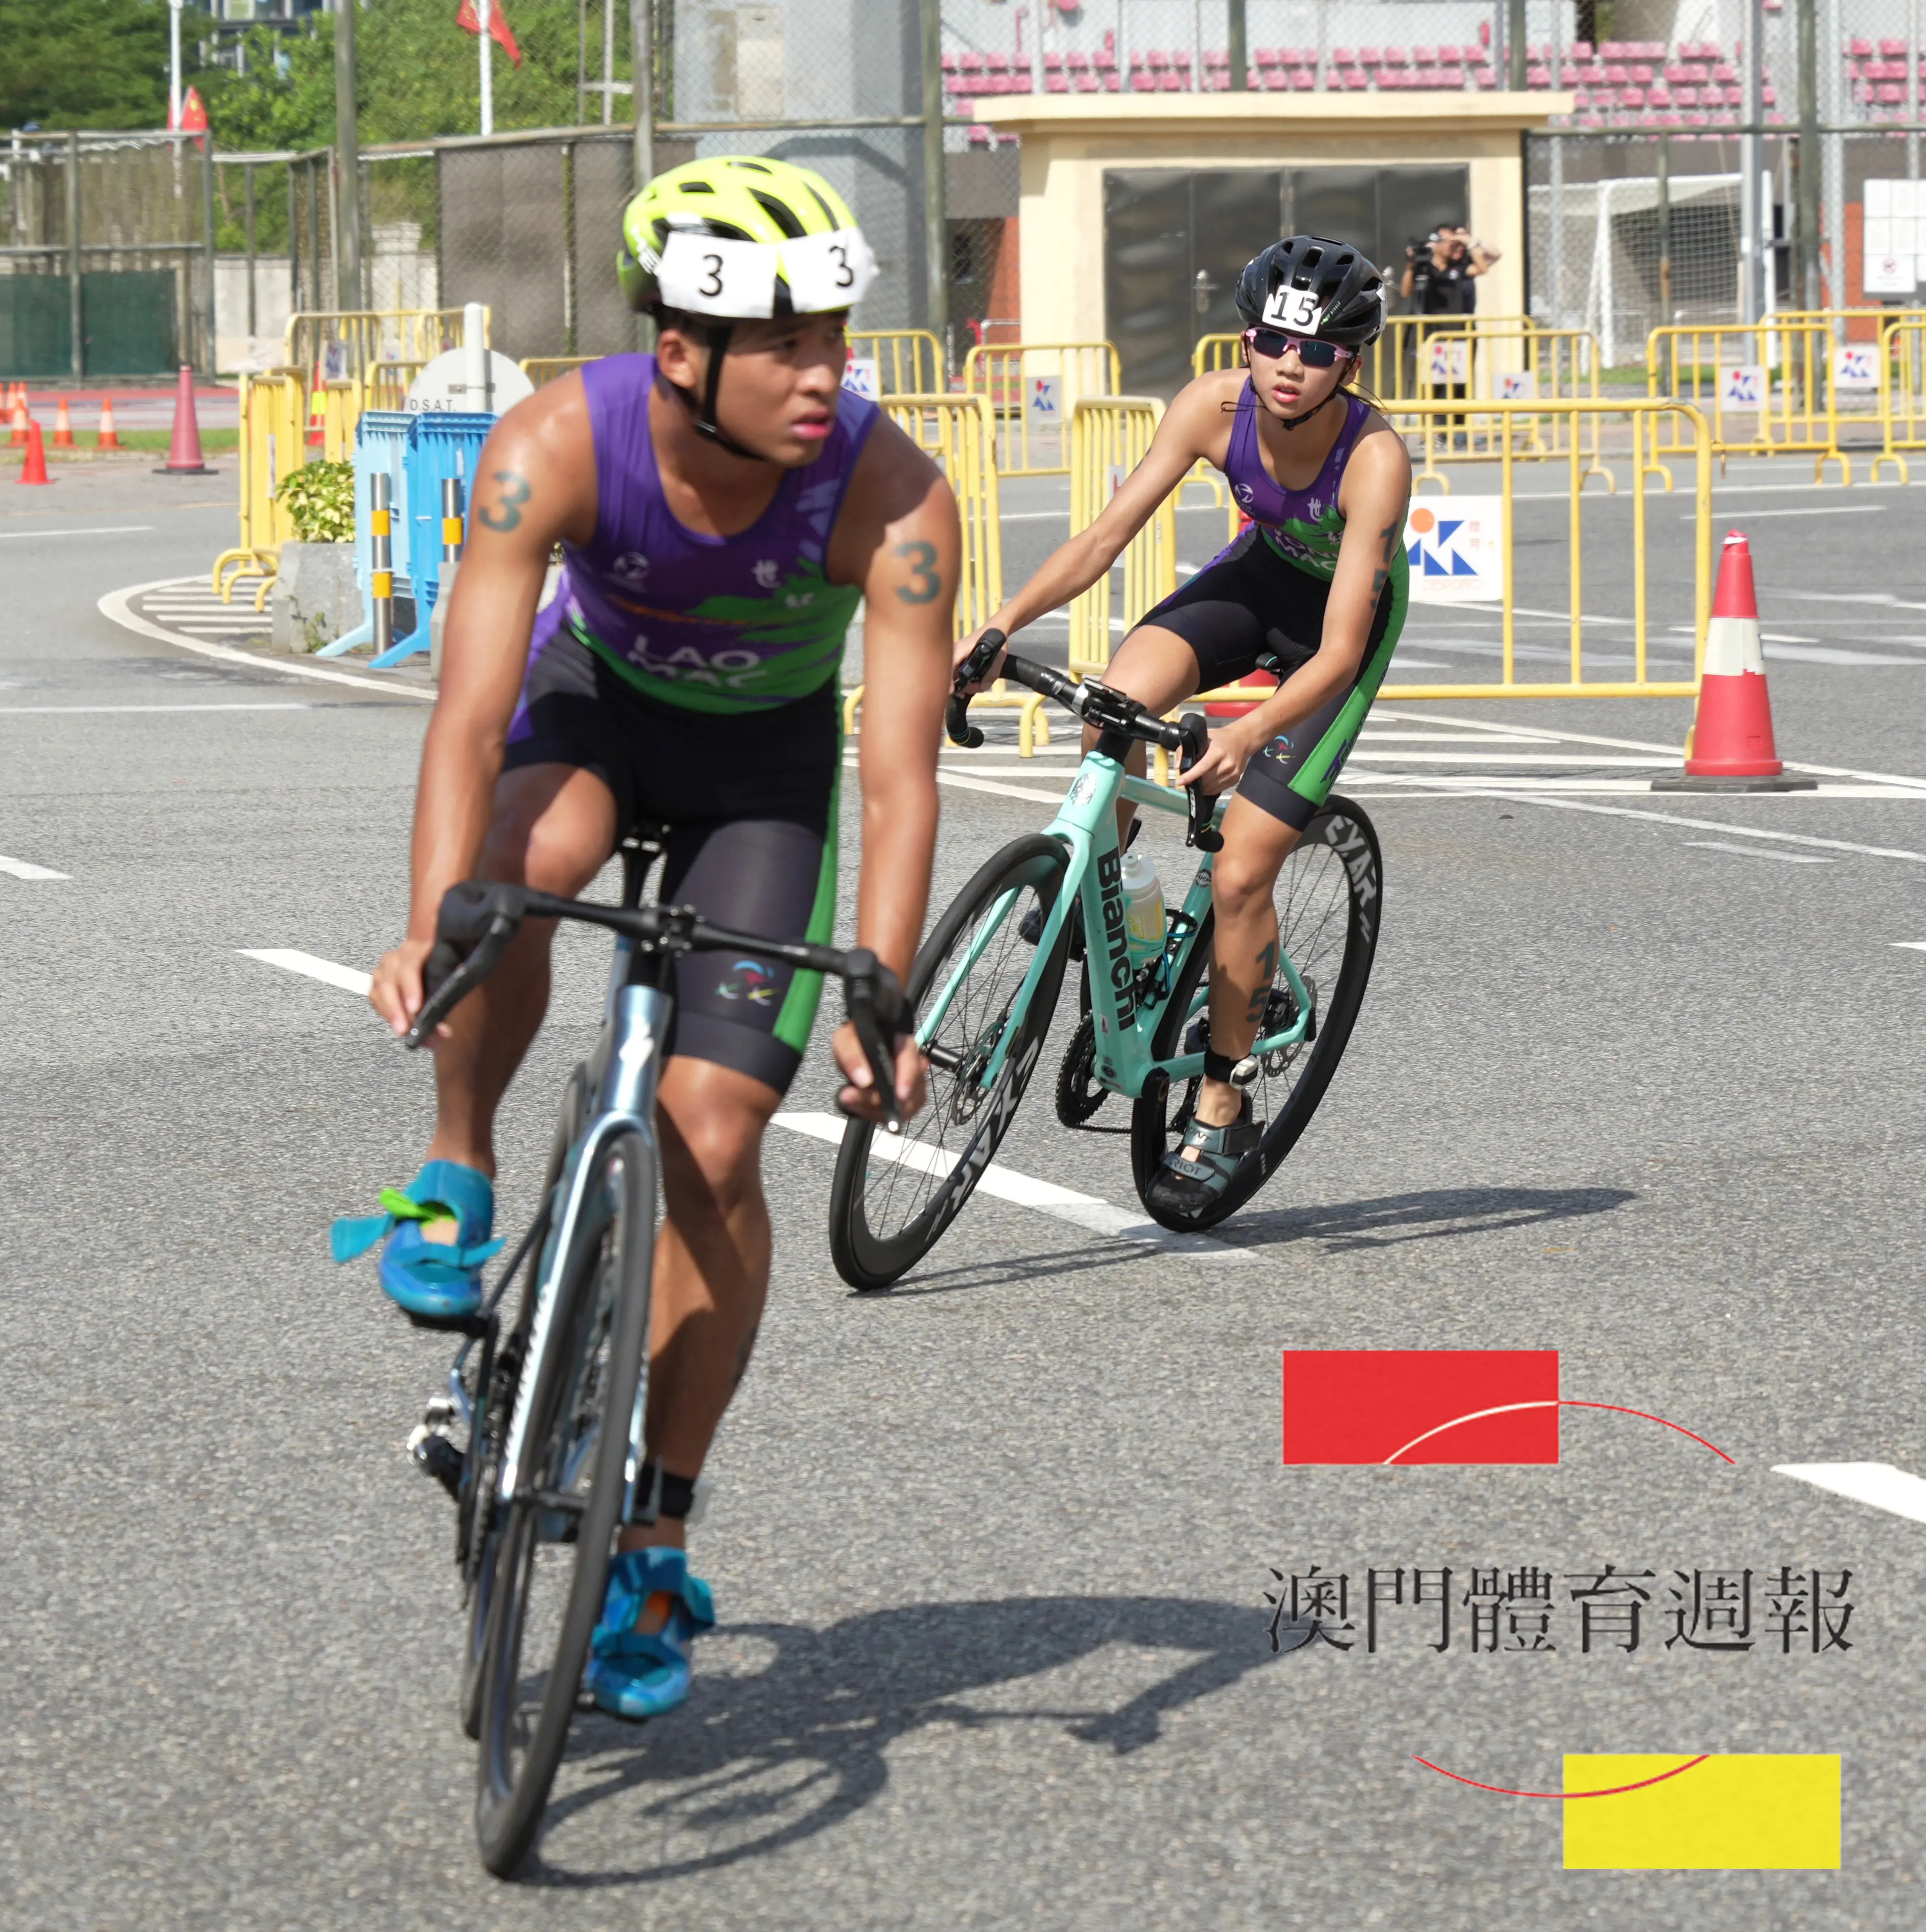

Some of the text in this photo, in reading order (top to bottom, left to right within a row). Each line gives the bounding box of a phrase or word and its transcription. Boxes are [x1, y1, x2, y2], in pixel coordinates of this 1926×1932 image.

[699, 254, 723, 297] 3
[829, 245, 854, 288] 3
[1271, 291, 1316, 326] 15
[478, 470, 532, 533] 3
[893, 541, 942, 605] 3
[1098, 846, 1136, 1031] Bianchi
[1170, 1158, 1202, 1176] RIOT
